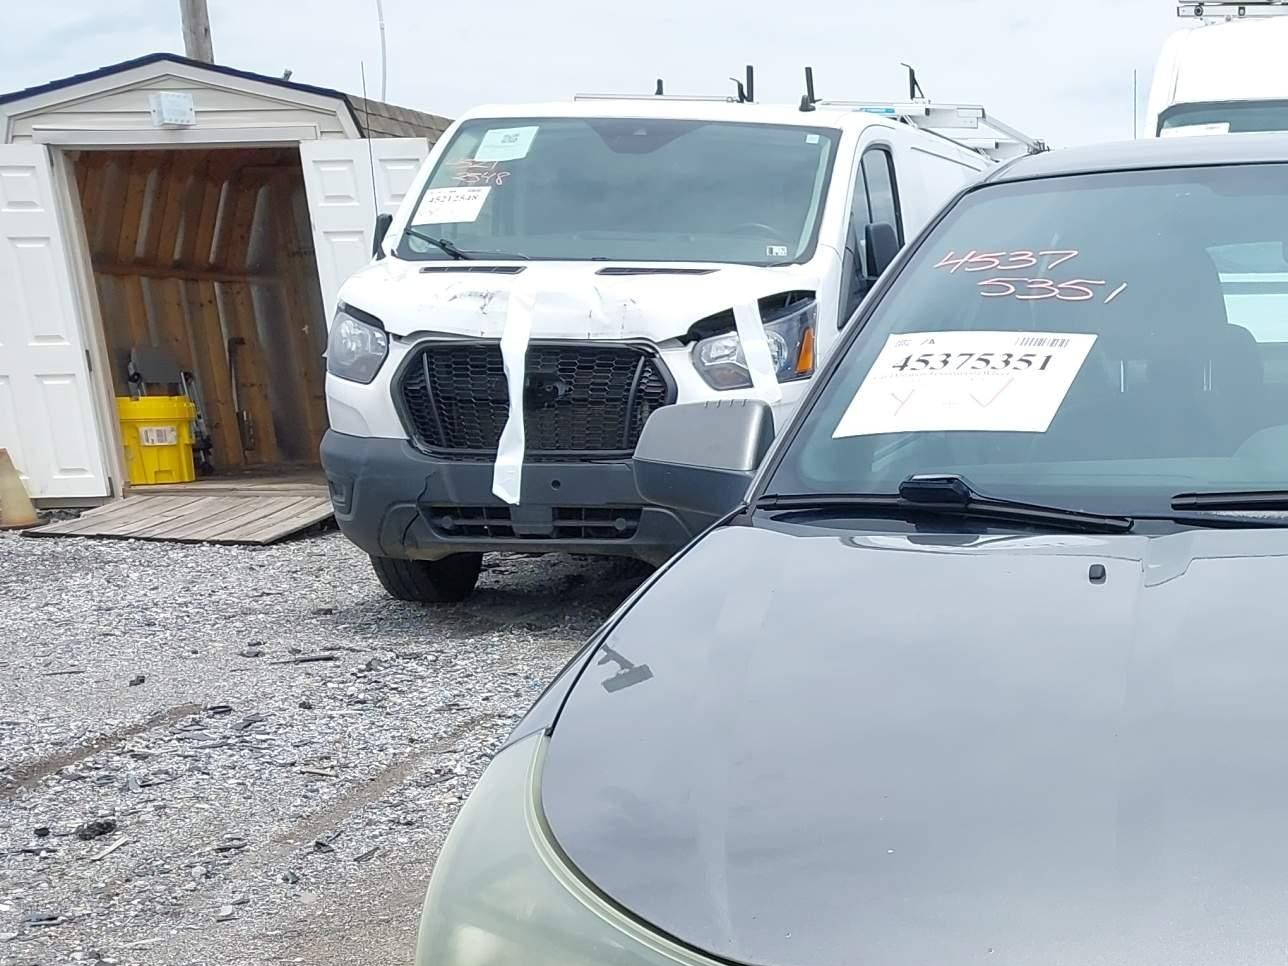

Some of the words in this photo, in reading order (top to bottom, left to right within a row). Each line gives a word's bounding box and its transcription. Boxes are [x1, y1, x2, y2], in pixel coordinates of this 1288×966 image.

[933, 250, 1079, 273] 4537
[977, 277, 1128, 304] 5351
[891, 352, 1054, 372] 45375351
